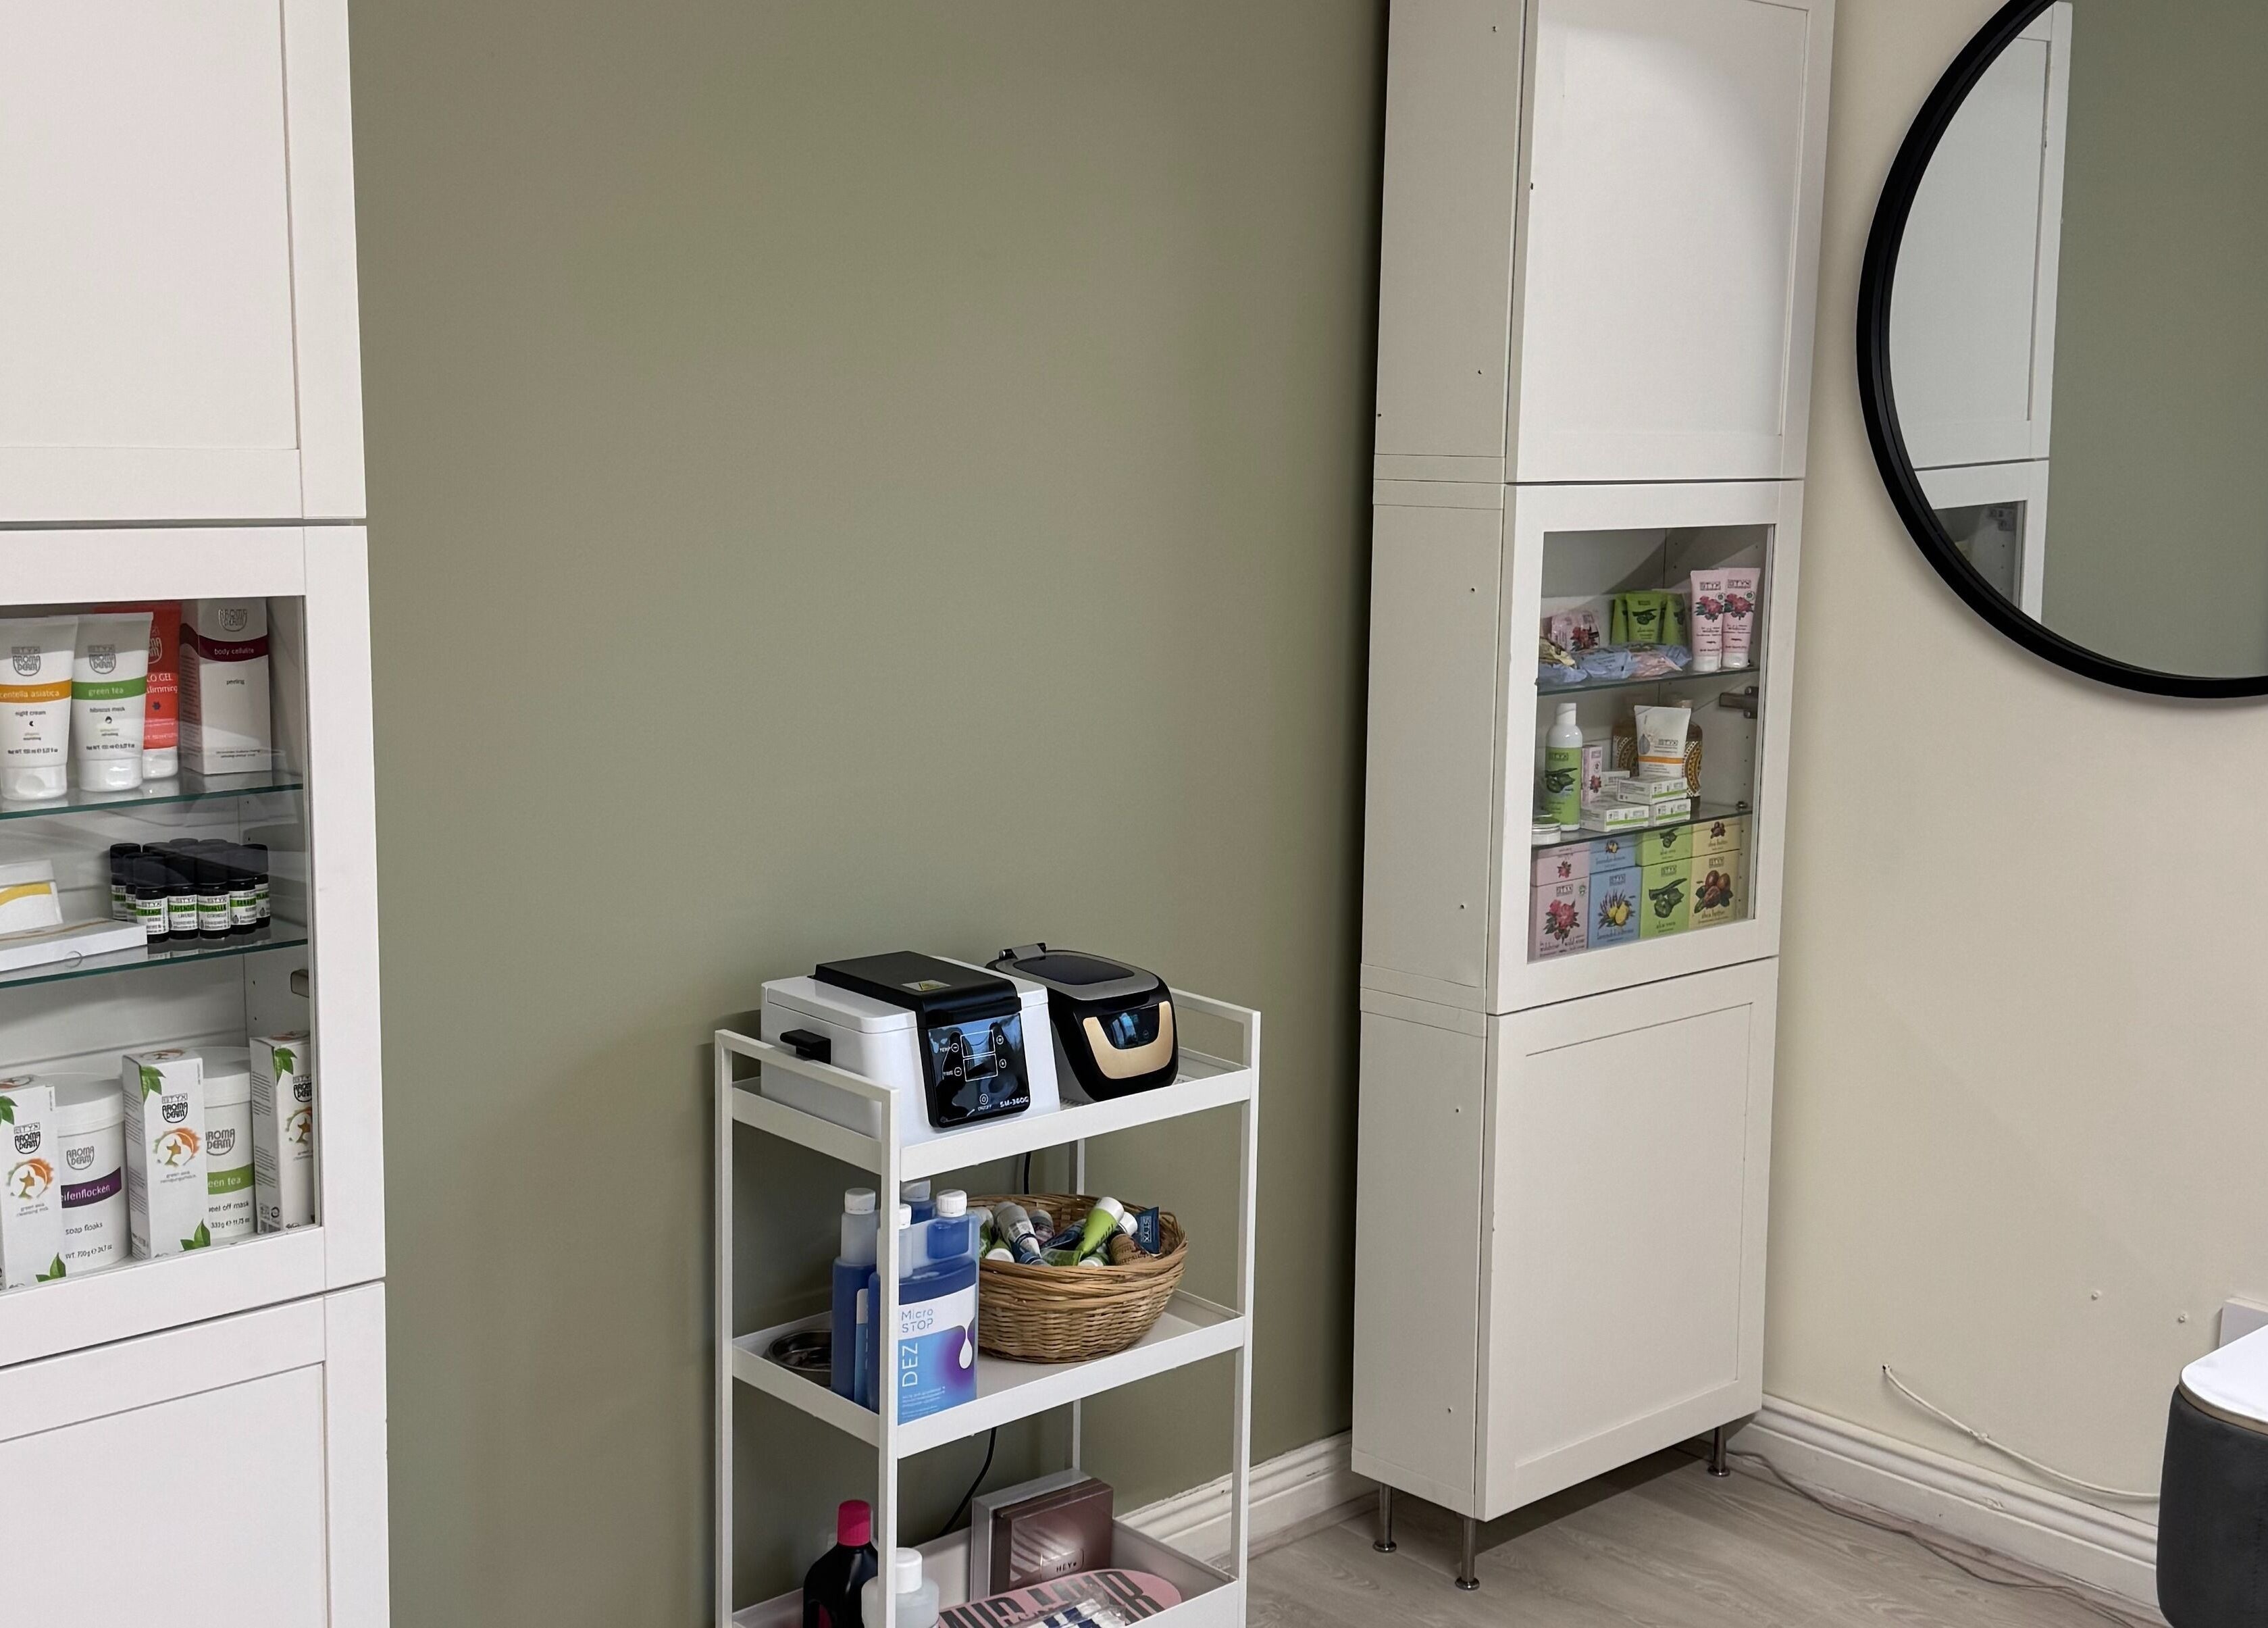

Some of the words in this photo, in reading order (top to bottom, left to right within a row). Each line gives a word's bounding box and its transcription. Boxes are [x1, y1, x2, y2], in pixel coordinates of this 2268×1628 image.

[159, 673, 172, 681] GEL
[88, 688, 109, 696] green
[162, 1102, 188, 1111] AROMA
[207, 1138, 232, 1149] DERM
[66, 1146, 94, 1157] AROMA
[71, 1154, 92, 1165] DERM
[61, 1184, 109, 1201] eifenflocken
[234, 1200, 249, 1209] mask
[901, 1308, 933, 1321] Micro
[902, 1318, 933, 1333] STOP
[902, 1342, 918, 1388] DEZ
